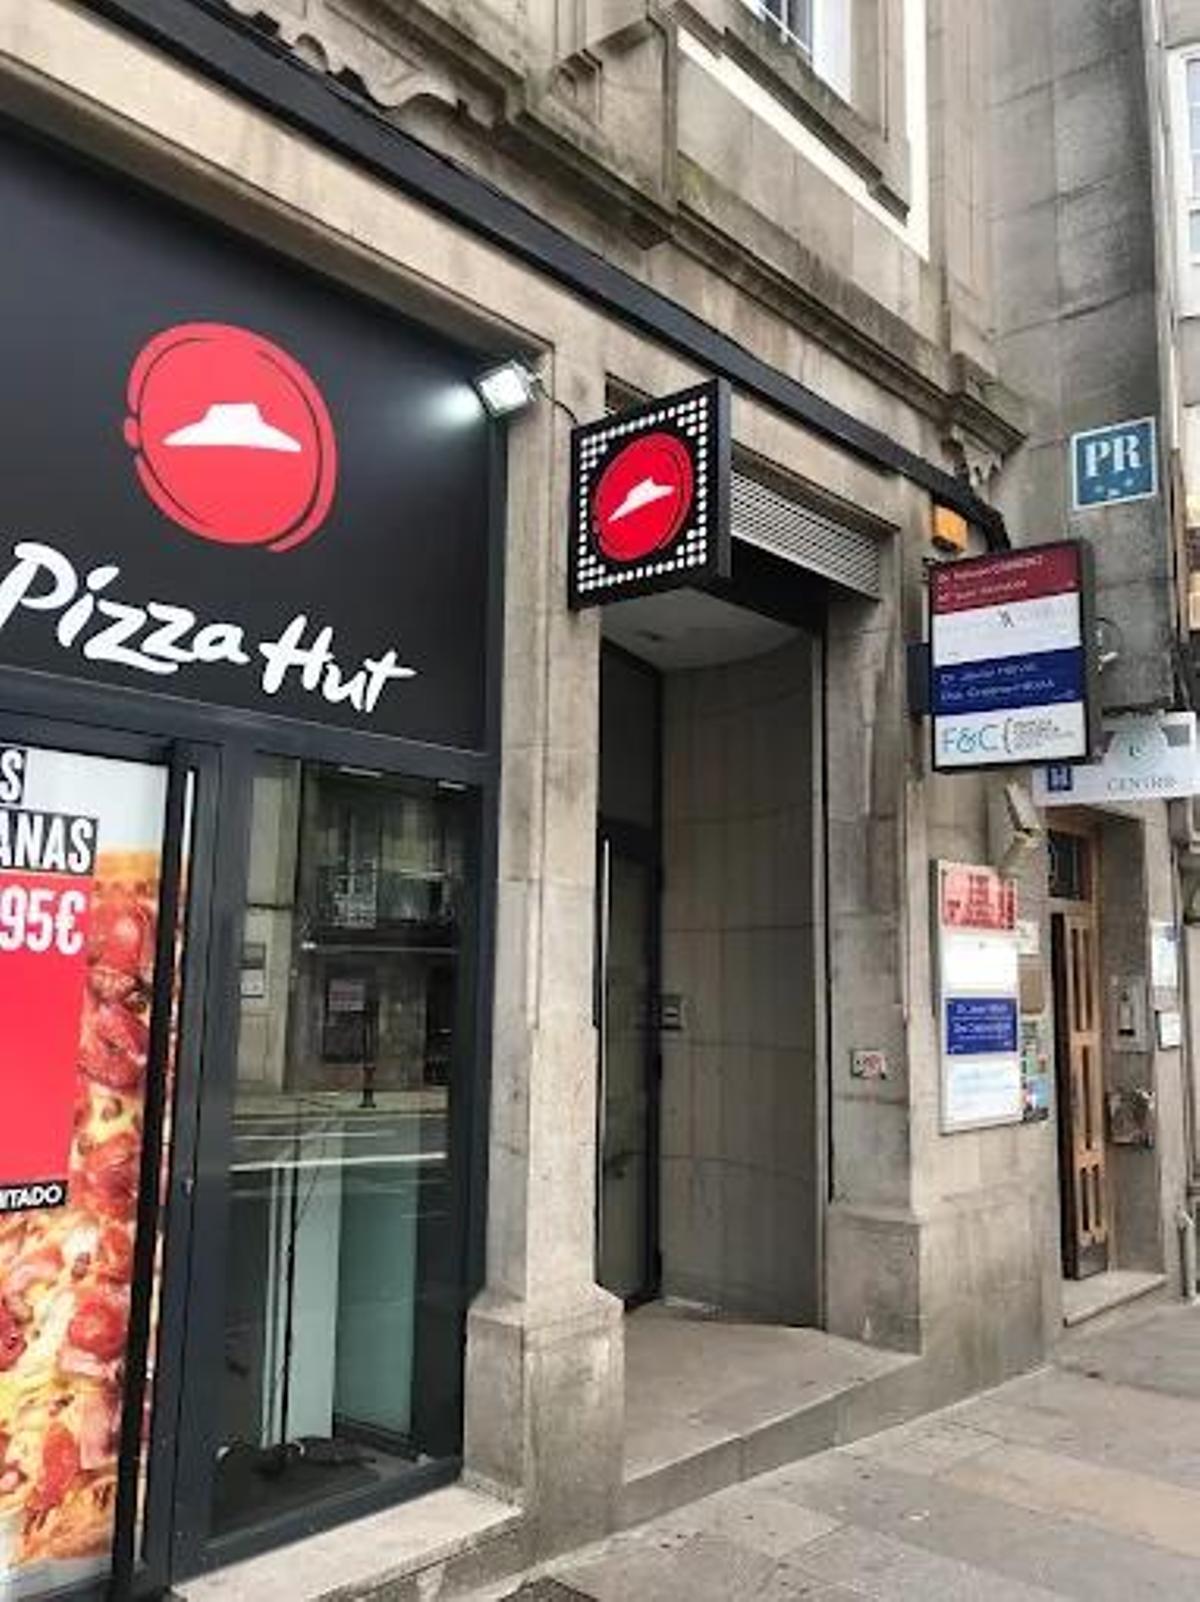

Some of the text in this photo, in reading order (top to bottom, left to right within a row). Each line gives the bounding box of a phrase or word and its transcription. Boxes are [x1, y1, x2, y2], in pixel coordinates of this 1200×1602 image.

[1084, 434, 1143, 478] PR
[0, 541, 418, 714] Pizza Hut
